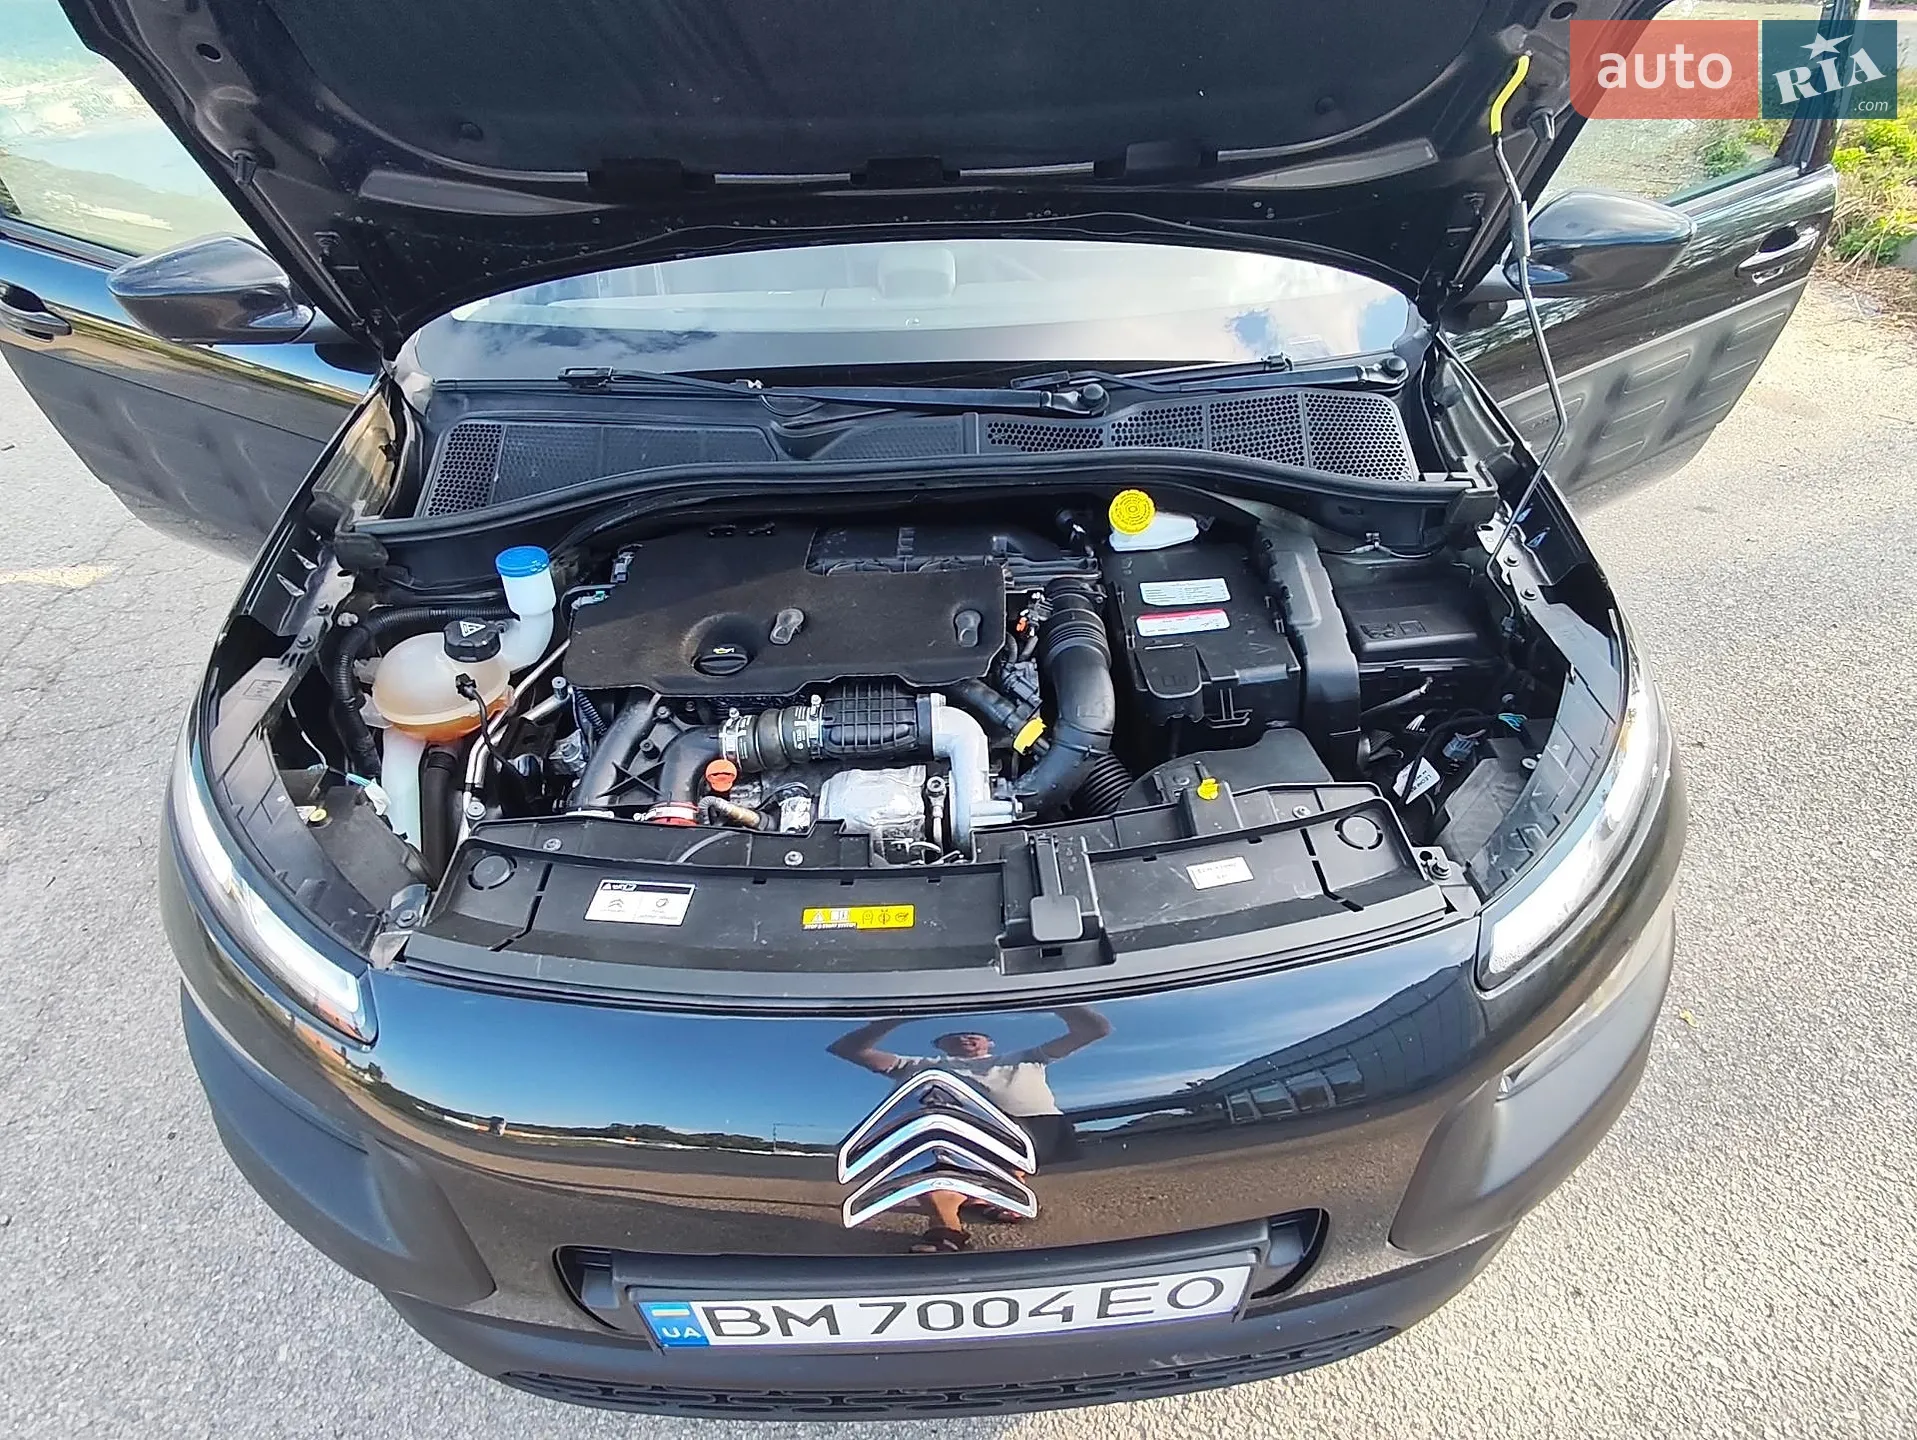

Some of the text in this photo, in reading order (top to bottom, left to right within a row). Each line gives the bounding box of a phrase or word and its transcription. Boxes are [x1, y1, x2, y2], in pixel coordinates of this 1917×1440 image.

[701, 1276, 1224, 1337] BM 7004 EO
[661, 1326, 702, 1338] UA
